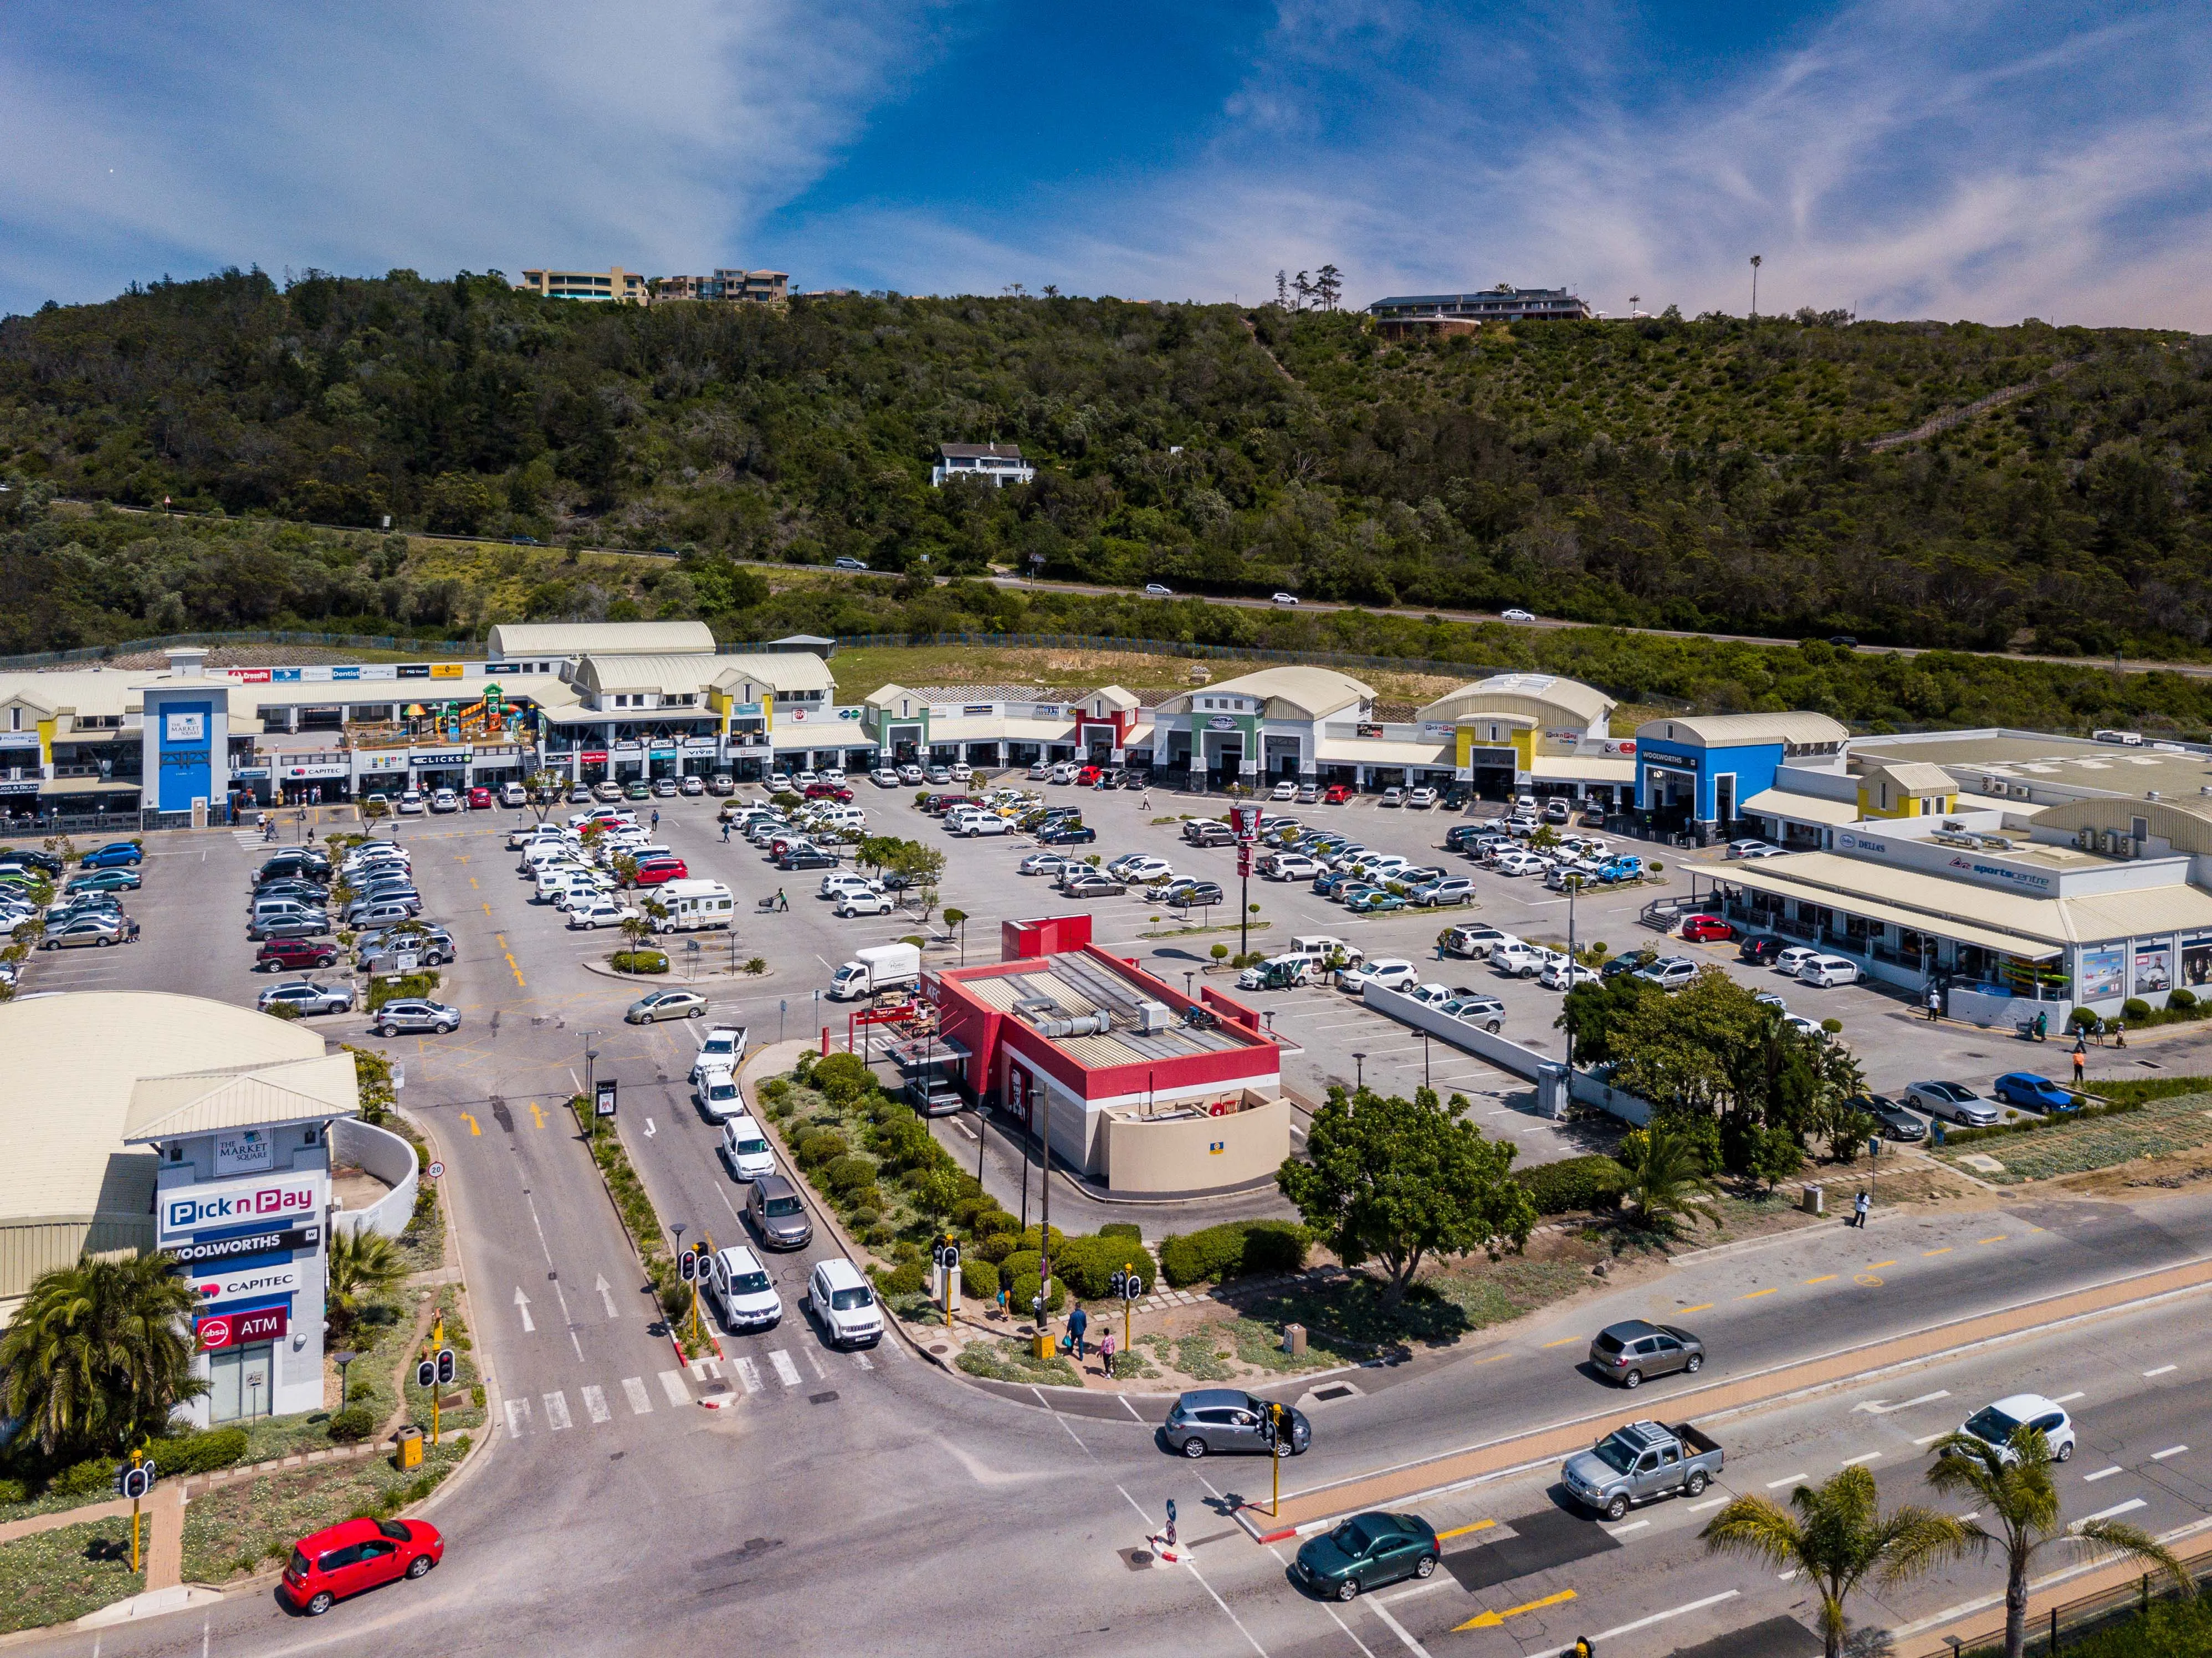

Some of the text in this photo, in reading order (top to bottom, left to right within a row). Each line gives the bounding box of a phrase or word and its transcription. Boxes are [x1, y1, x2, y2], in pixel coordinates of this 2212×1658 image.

[421, 755, 462, 764] CLICKS
[1642, 751, 1682, 764] WOOLWORTHS
[1973, 864, 2049, 886] sportscentre
[926, 982, 941, 1004] KFC
[219, 1143, 268, 1157] MARKET
[220, 1140, 235, 1149] THE
[237, 1150, 268, 1162] SQUARE
[170, 1189, 313, 1226] Pick n Pay
[227, 1274, 294, 1293] CAPITEC
[241, 1316, 278, 1335] ATM
[205, 1328, 225, 1338] absa
